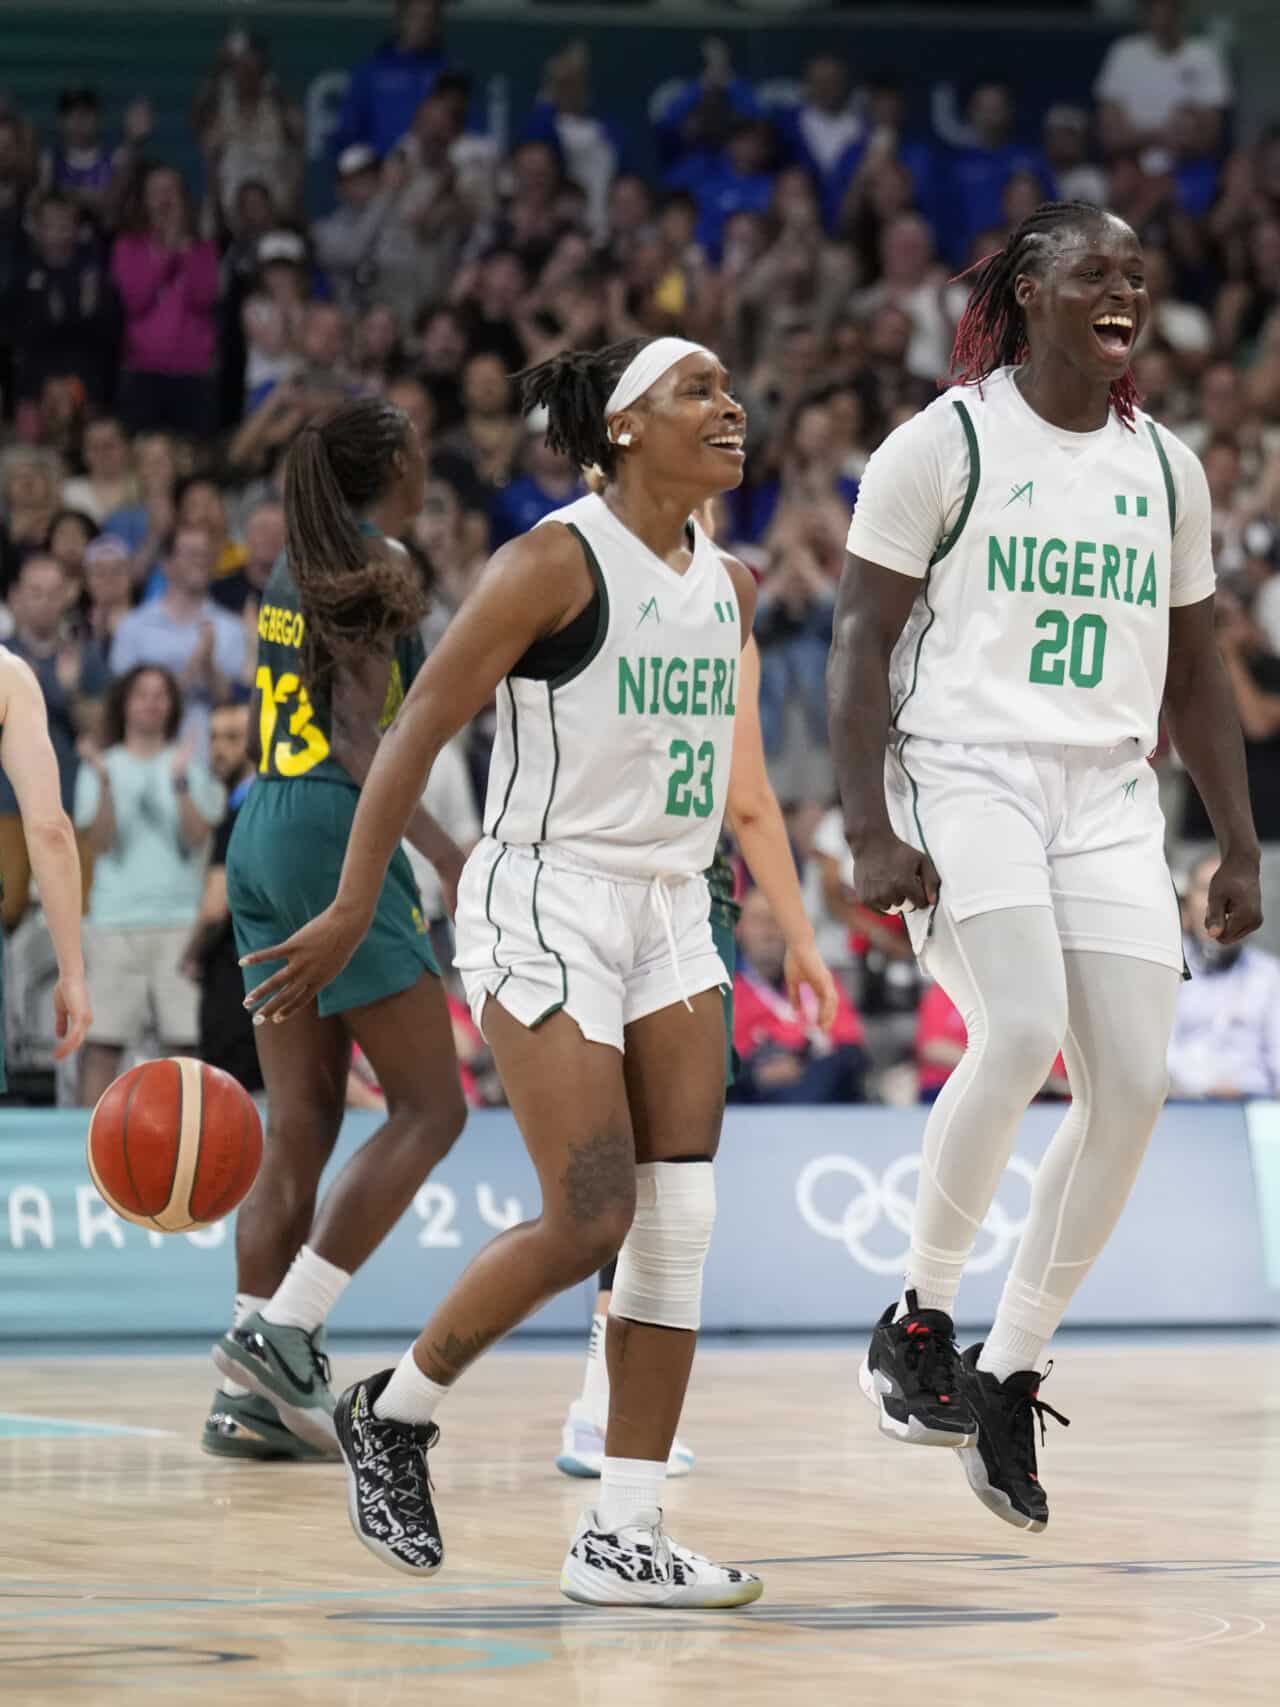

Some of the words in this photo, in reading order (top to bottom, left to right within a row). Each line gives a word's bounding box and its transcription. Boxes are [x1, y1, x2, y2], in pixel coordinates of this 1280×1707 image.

[987, 535, 1158, 608] NIGERIA
[1029, 609, 1107, 689] 20
[256, 665, 331, 778] 13
[664, 739, 715, 818] 23
[8, 1184, 228, 1249] AR
